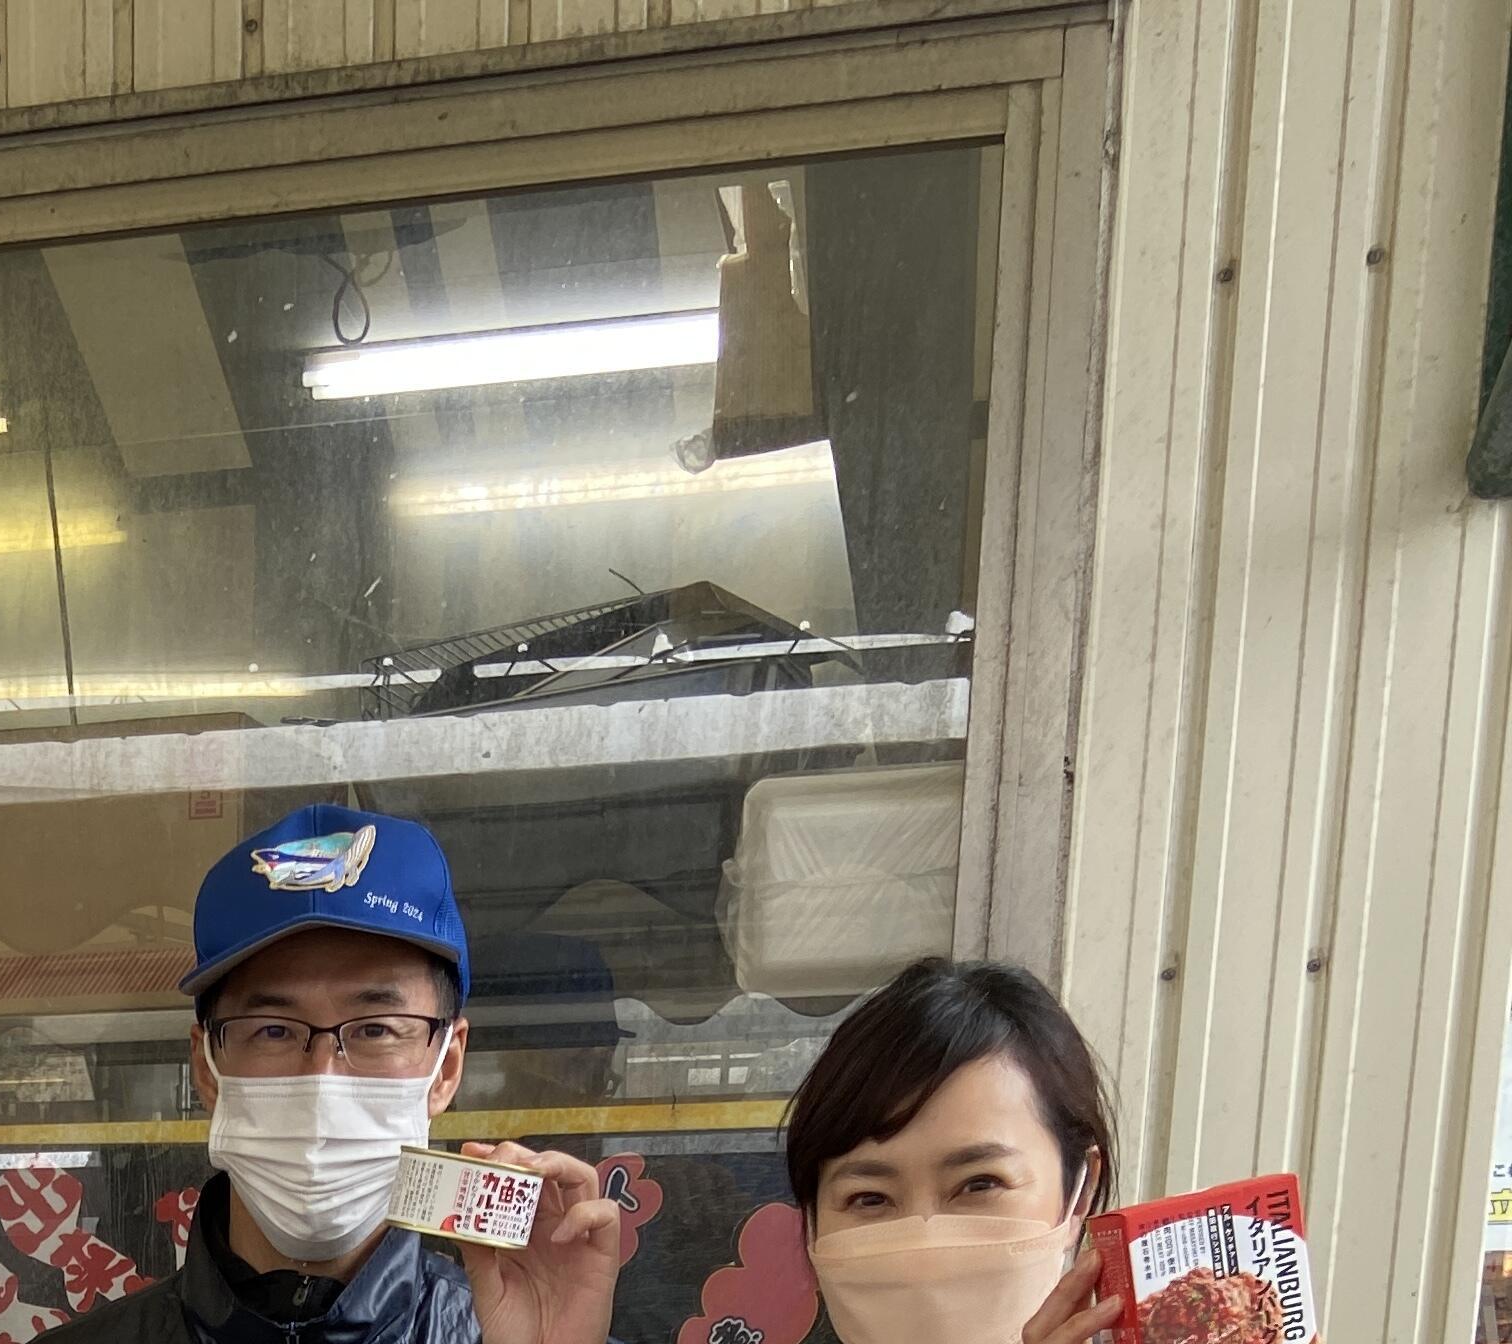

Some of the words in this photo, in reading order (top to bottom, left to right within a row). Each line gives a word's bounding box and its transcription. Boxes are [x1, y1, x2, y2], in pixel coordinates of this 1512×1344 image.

[363, 891, 399, 915] Spring
[403, 902, 424, 922] 2024
[474, 1172, 500, 1233] カルビ
[1267, 1189, 1306, 1341] ITALIANBURG
